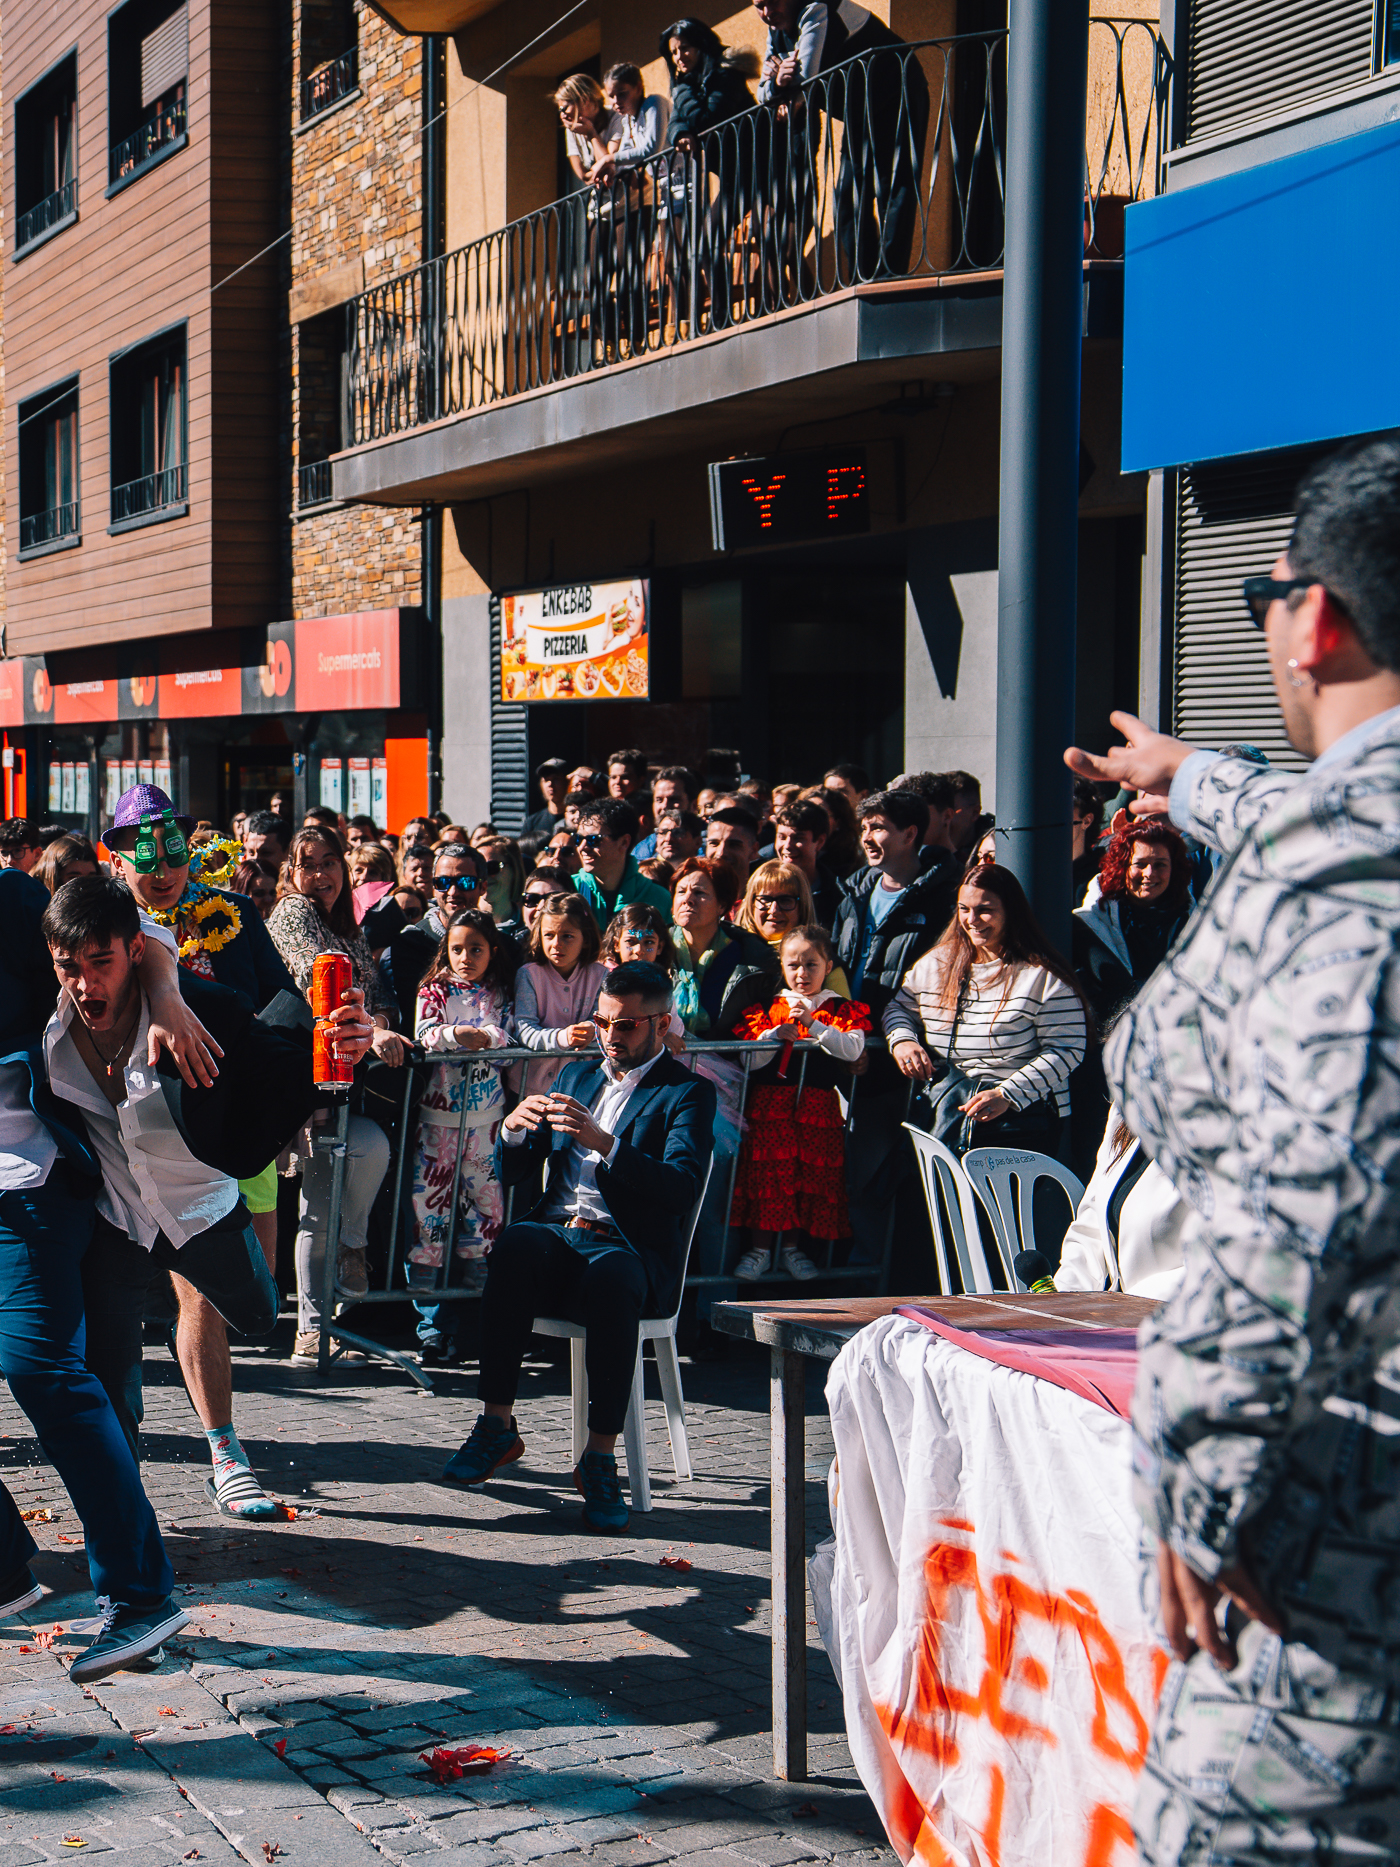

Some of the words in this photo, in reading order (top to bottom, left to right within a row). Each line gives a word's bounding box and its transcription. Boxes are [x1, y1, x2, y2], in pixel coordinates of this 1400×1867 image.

[741, 474, 786, 528] Y
[826, 465, 865, 519] P
[544, 634, 589, 658] PIZZERIA
[318, 647, 382, 676] Supermercats
